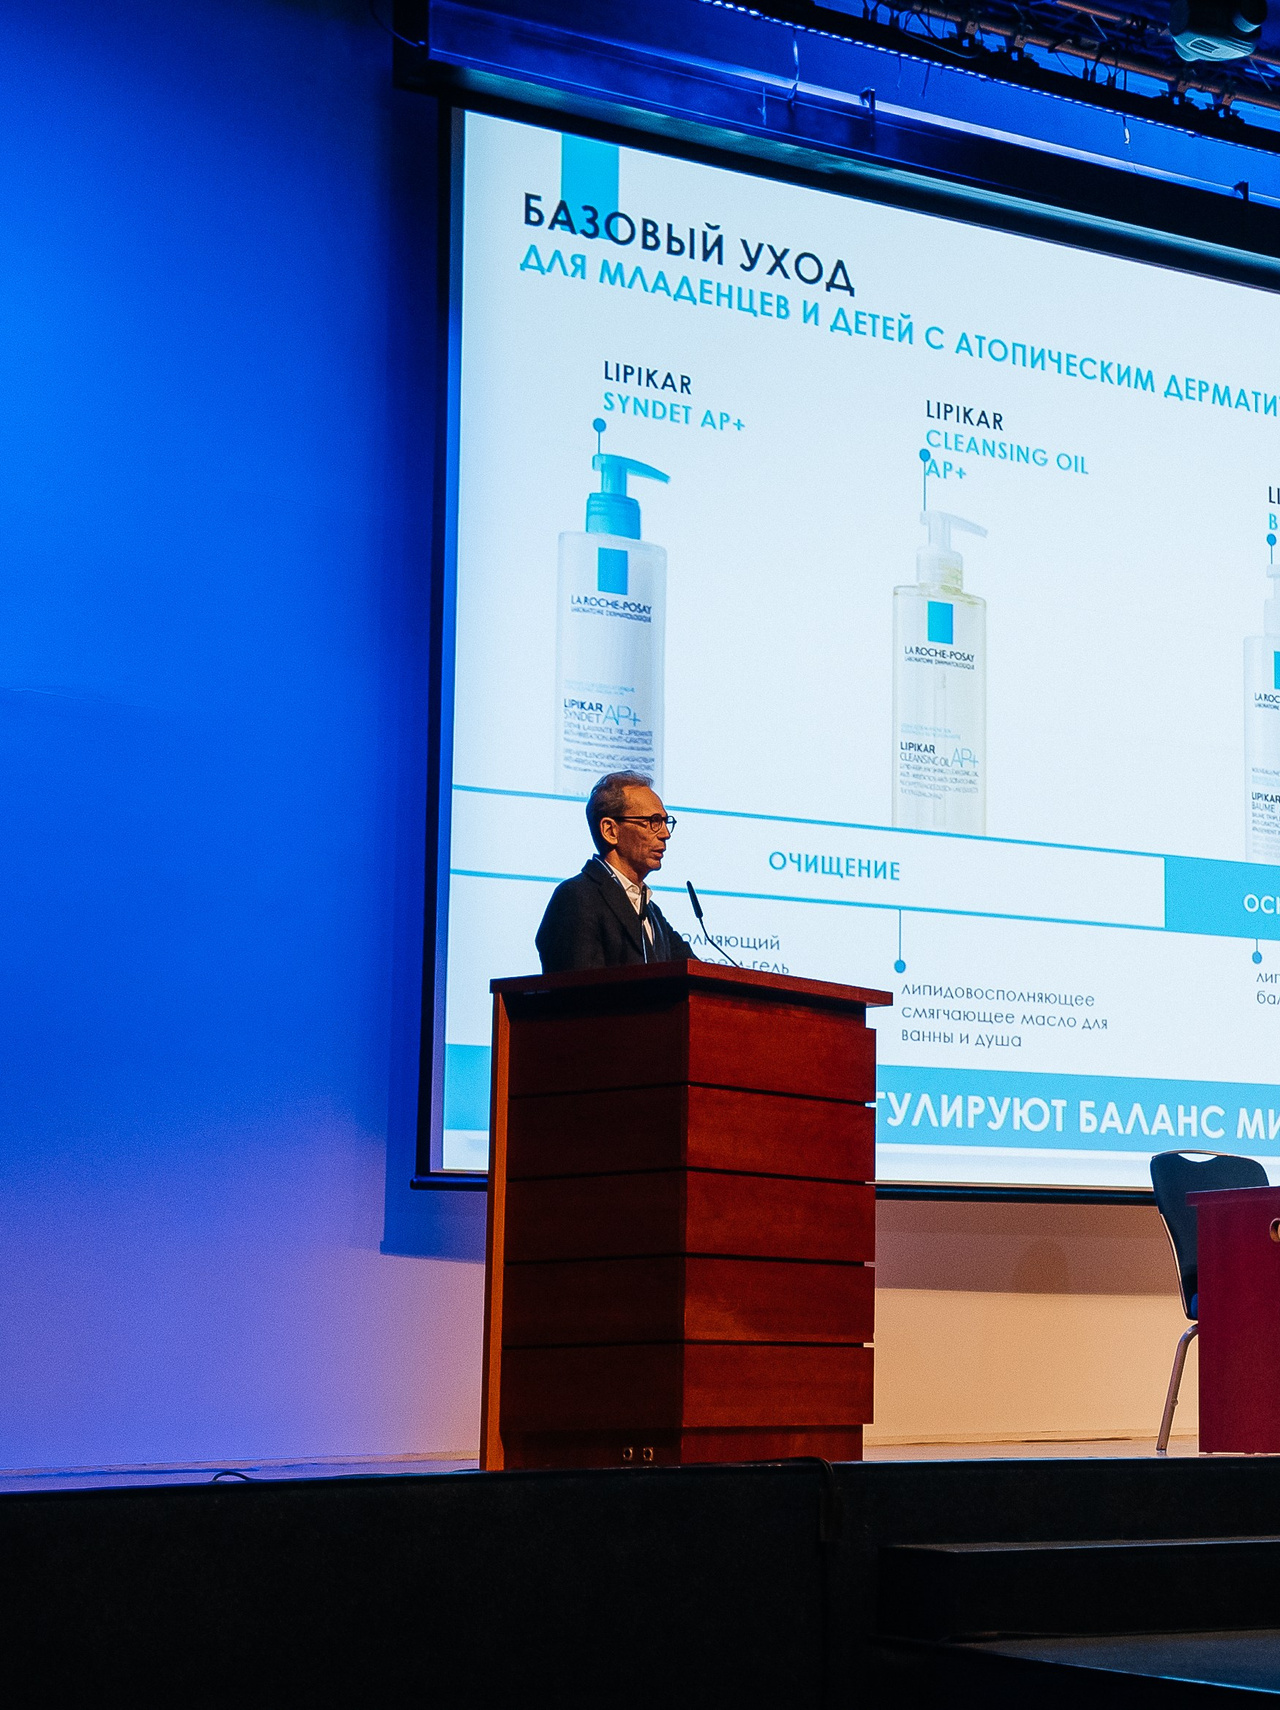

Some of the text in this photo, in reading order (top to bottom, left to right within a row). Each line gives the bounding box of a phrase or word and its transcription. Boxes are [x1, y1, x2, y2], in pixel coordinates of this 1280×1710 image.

[523, 192, 855, 297] БАЗОВЫЙ УХОД
[520, 244, 586, 279] ДЛЯ
[599, 257, 791, 320] МЛАДЕНЦЕВ
[803, 299, 820, 326] И
[830, 307, 914, 345] ДЕТЕЙ
[925, 326, 945, 350] С
[955, 332, 1155, 393] АТОПИЧЕСКИМ
[604, 361, 692, 395] LIPIKAR
[603, 392, 746, 432] SYNDET AP+
[926, 400, 1004, 431] LIPIKAR
[926, 429, 1089, 475] CLEANSING OIL
[925, 458, 967, 481] AP+
[564, 698, 604, 713] LIPIKAR
[602, 704, 642, 727] AP+
[900, 741, 936, 755] LIPIKAR
[950, 747, 979, 768] AP+
[1251, 792, 1280, 804] LIPIKAR
[768, 851, 901, 882] ОЧИЩЕНИЕ
[901, 983, 1095, 1008] липидовосполняющее
[901, 1006, 1108, 1032] смягчающее масло для
[901, 1028, 1022, 1049] ванны и душа
[876, 1091, 1067, 1132] УЛИРУЮТ
[1080, 1099, 1226, 1140] БАЛАНС
